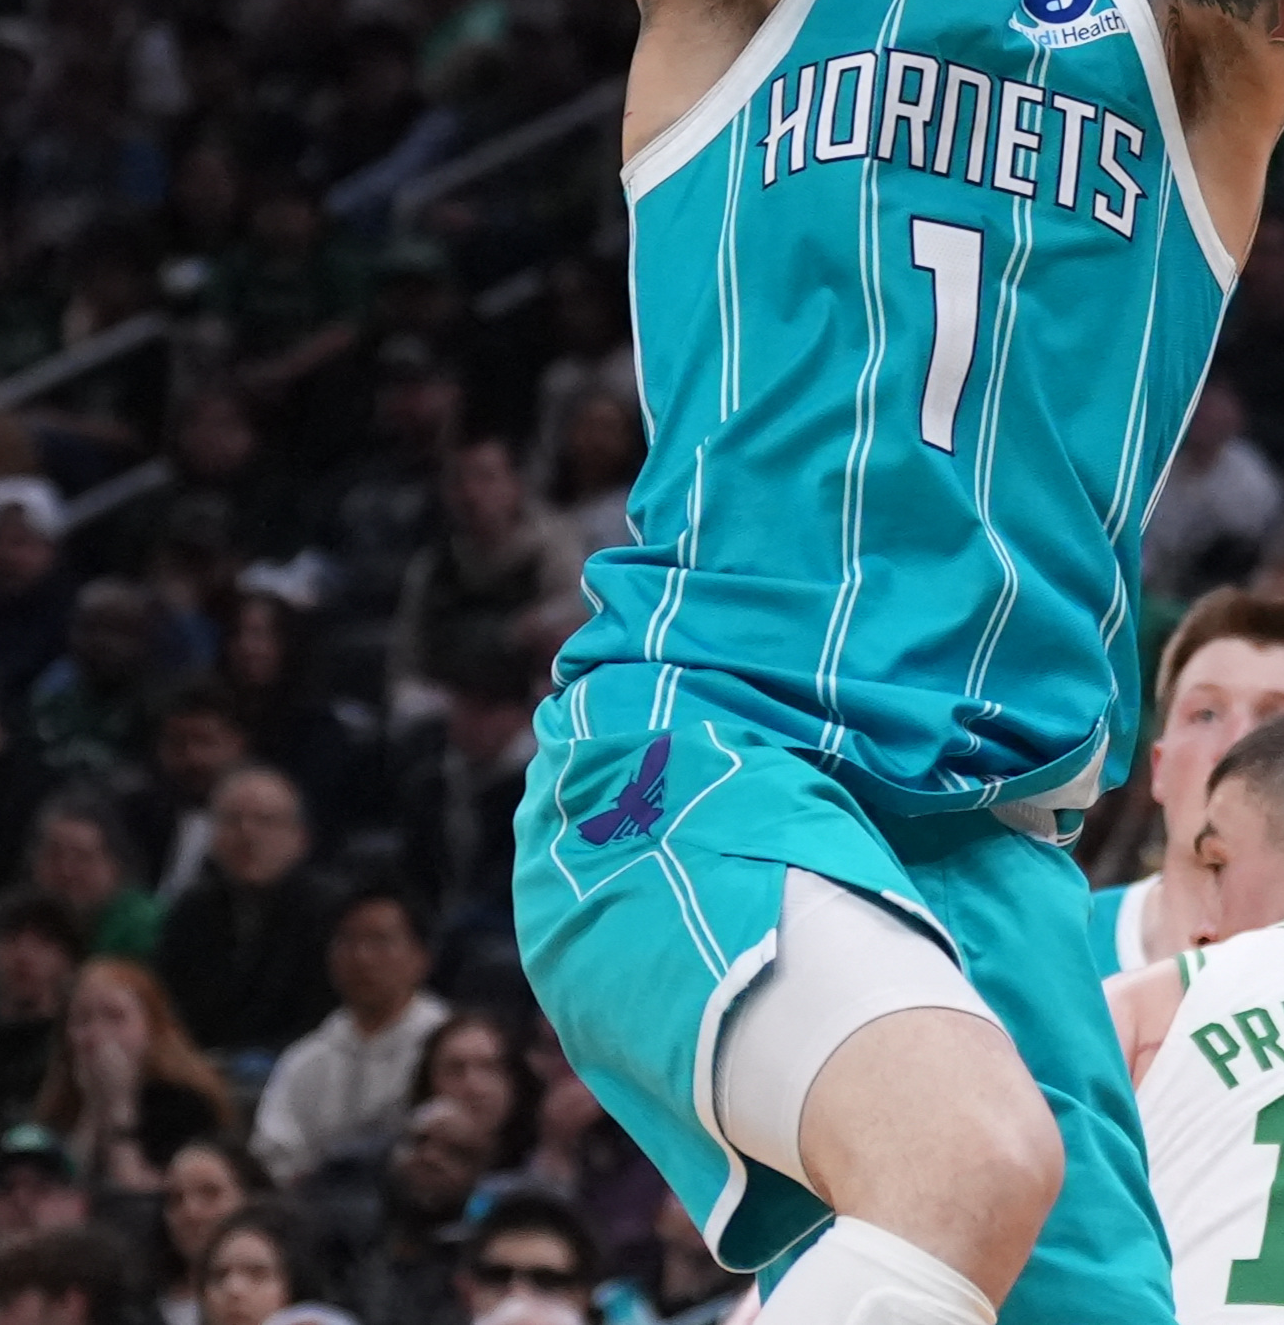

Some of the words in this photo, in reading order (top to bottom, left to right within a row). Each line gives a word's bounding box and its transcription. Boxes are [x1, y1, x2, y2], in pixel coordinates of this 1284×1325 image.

[1062, 10, 1126, 45] Health
[757, 48, 1147, 241] HORNETS
[909, 214, 984, 456] 1
